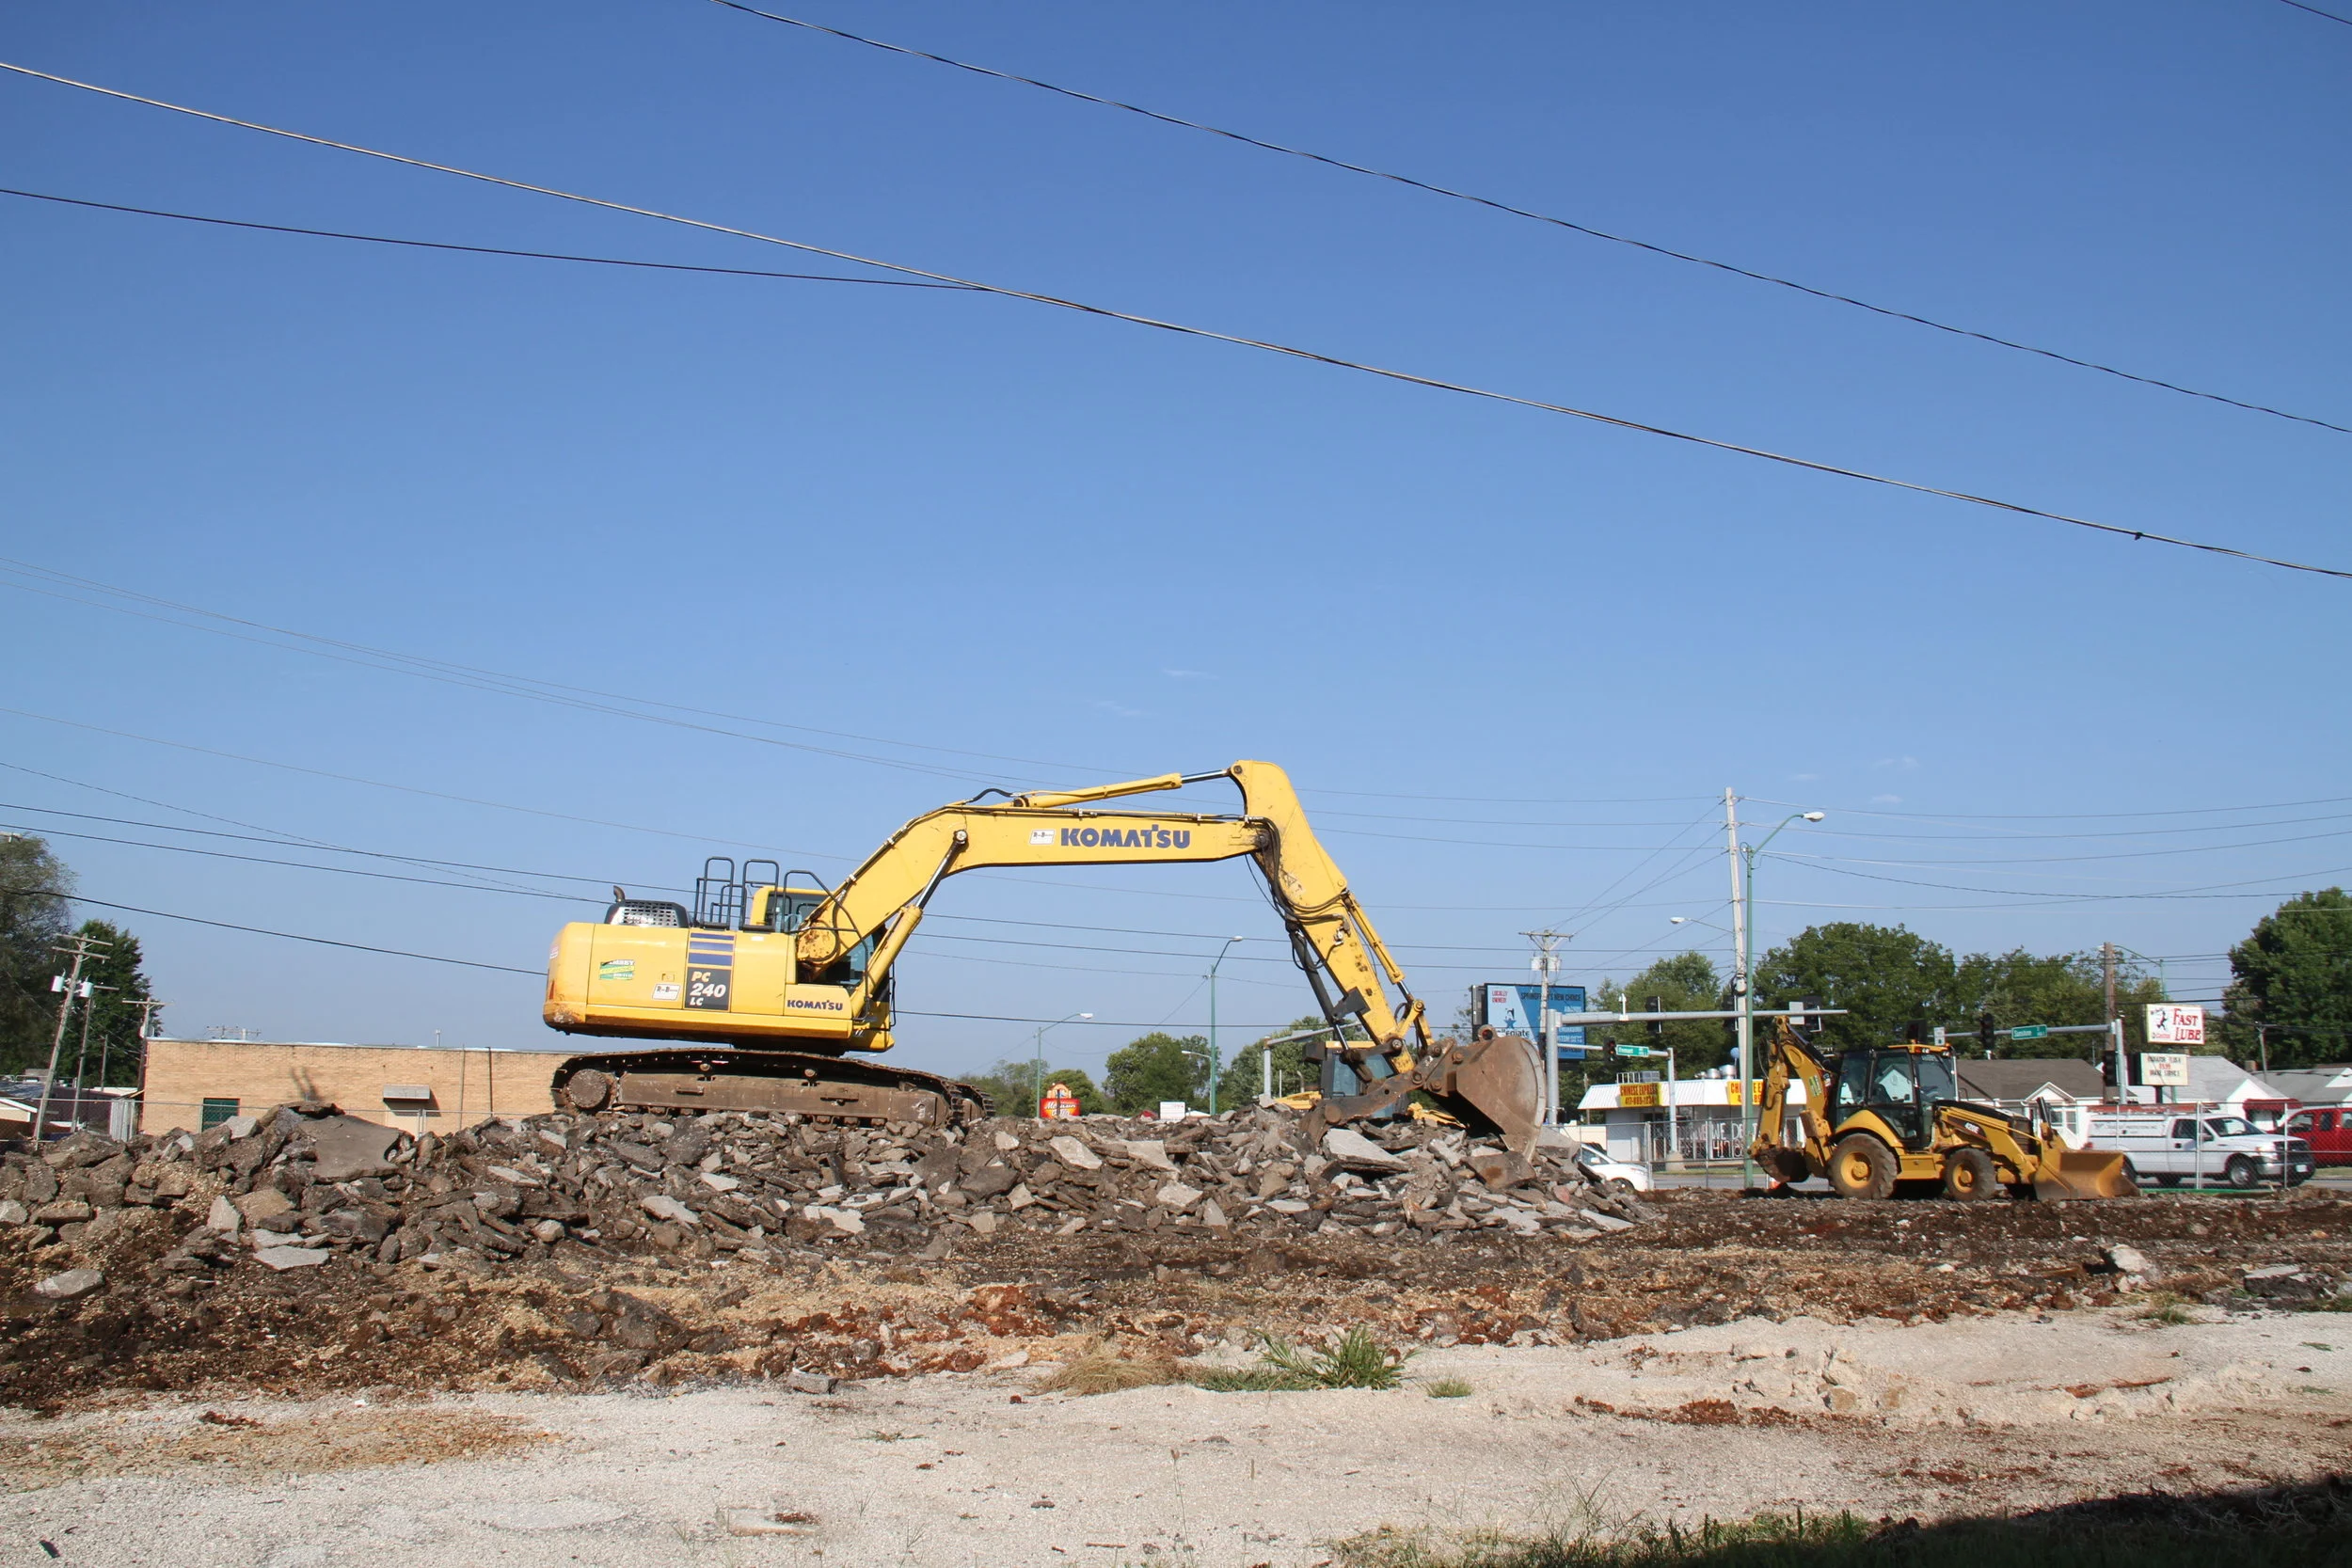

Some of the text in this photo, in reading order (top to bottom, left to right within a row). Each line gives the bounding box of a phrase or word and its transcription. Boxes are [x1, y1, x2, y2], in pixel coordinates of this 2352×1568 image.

[1060, 824, 1190, 848] KOMATSU
[691, 971, 711, 983] PC
[690, 982, 726, 998] 240
[690, 997, 705, 1006] LC
[787, 999, 843, 1011] KOMATSU
[2172, 1007, 2199, 1026] FAST
[2174, 1027, 2201, 1041] LUBE
[1620, 1083, 1658, 1096] CHINESE EXPRESS
